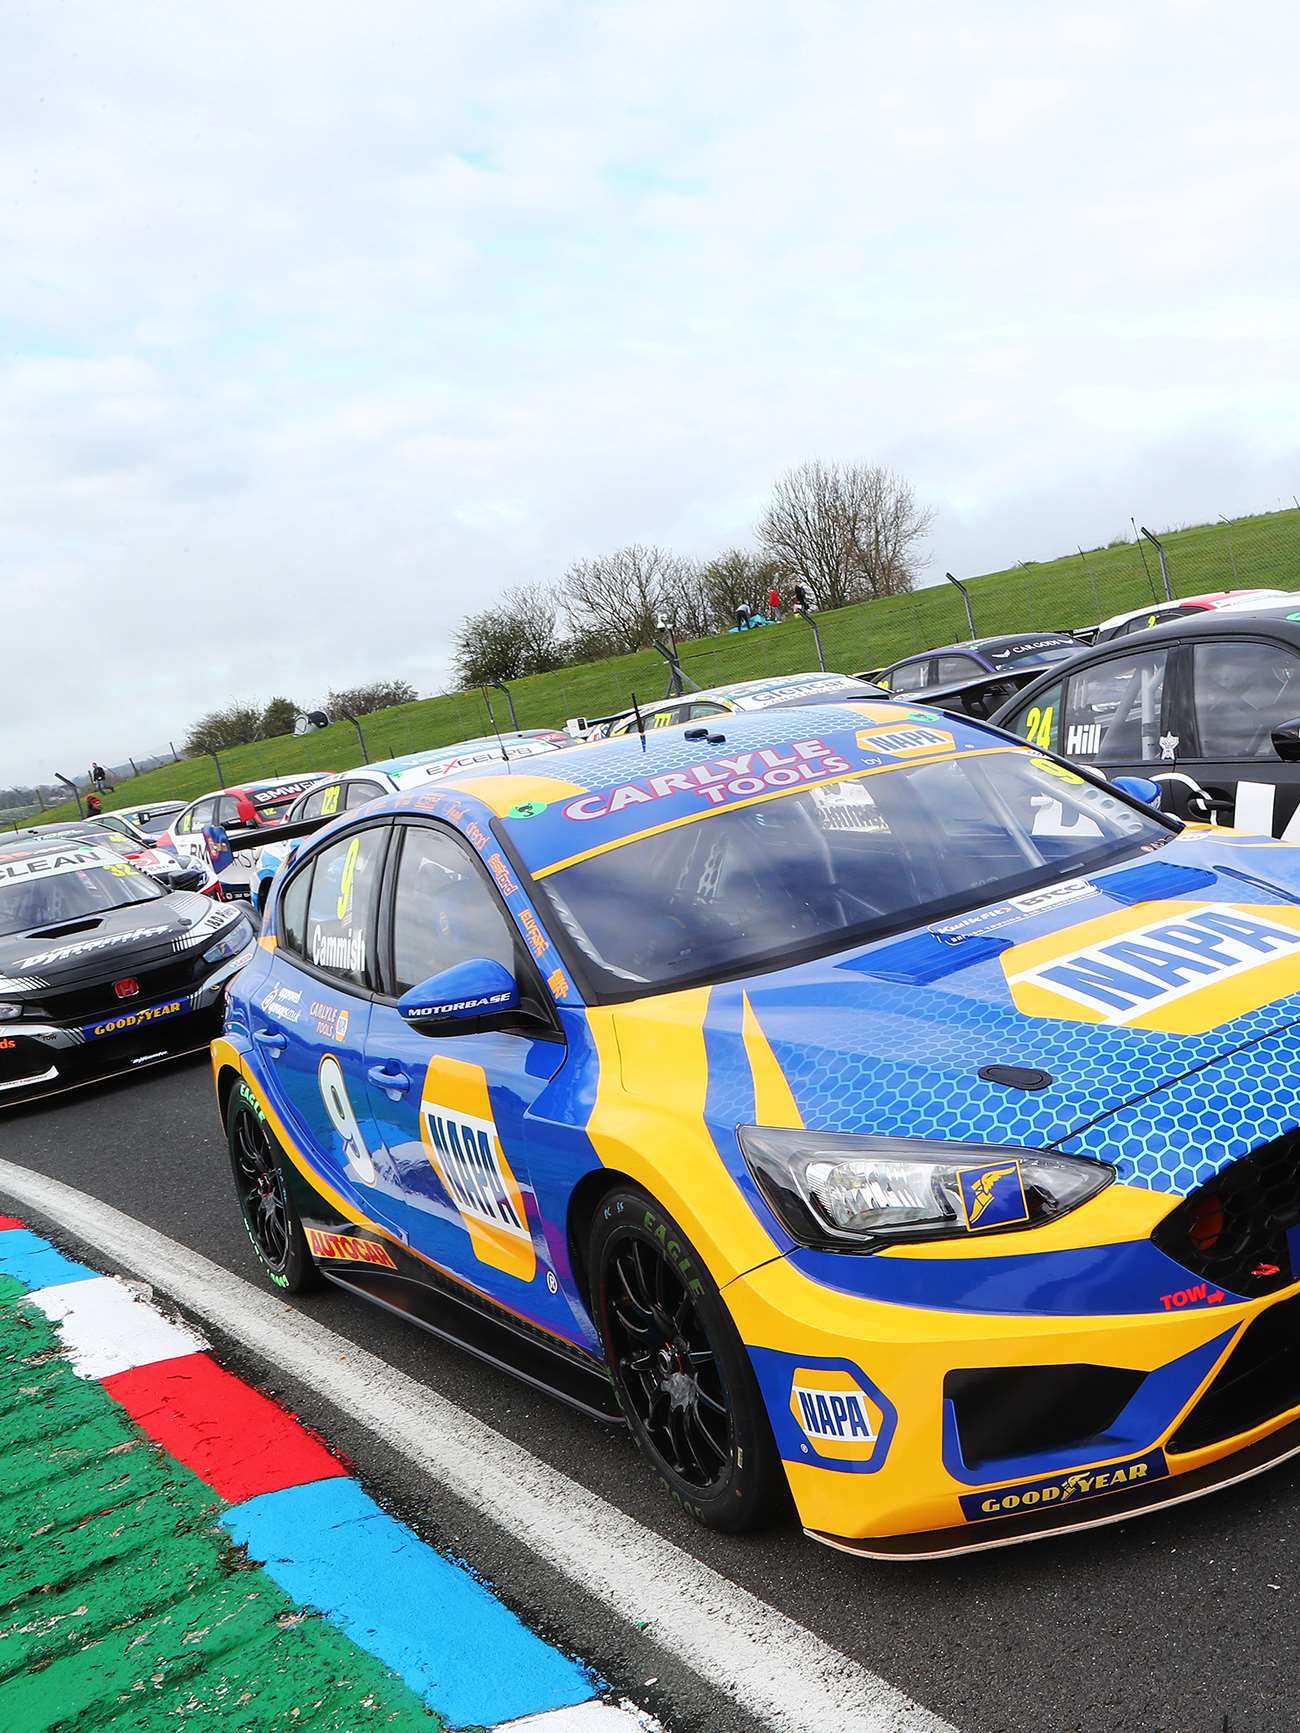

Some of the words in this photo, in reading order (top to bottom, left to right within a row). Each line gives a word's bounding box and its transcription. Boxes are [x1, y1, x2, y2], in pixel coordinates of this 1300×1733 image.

[866, 727, 947, 752] NAPA
[1026, 706, 1055, 750] 24
[1066, 723, 1101, 755] Hill
[563, 738, 833, 821] CARLYLE
[694, 754, 852, 804] TOOLS
[862, 755, 883, 767] by
[1029, 758, 1085, 785] 9
[253, 784, 302, 803] BMW
[321, 785, 341, 816] 123
[102, 863, 141, 877] 32
[336, 837, 360, 921] 9
[312, 923, 366, 972] Cammish
[407, 991, 512, 1017] MOTORBASE
[317, 1052, 377, 1188] 9
[427, 1113, 523, 1230] NAPA
[309, 1229, 398, 1270] AUTOCAR
[643, 1210, 706, 1296] EAGLE
[1159, 1283, 1209, 1311] TOW
[799, 1390, 870, 1438] NAPA
